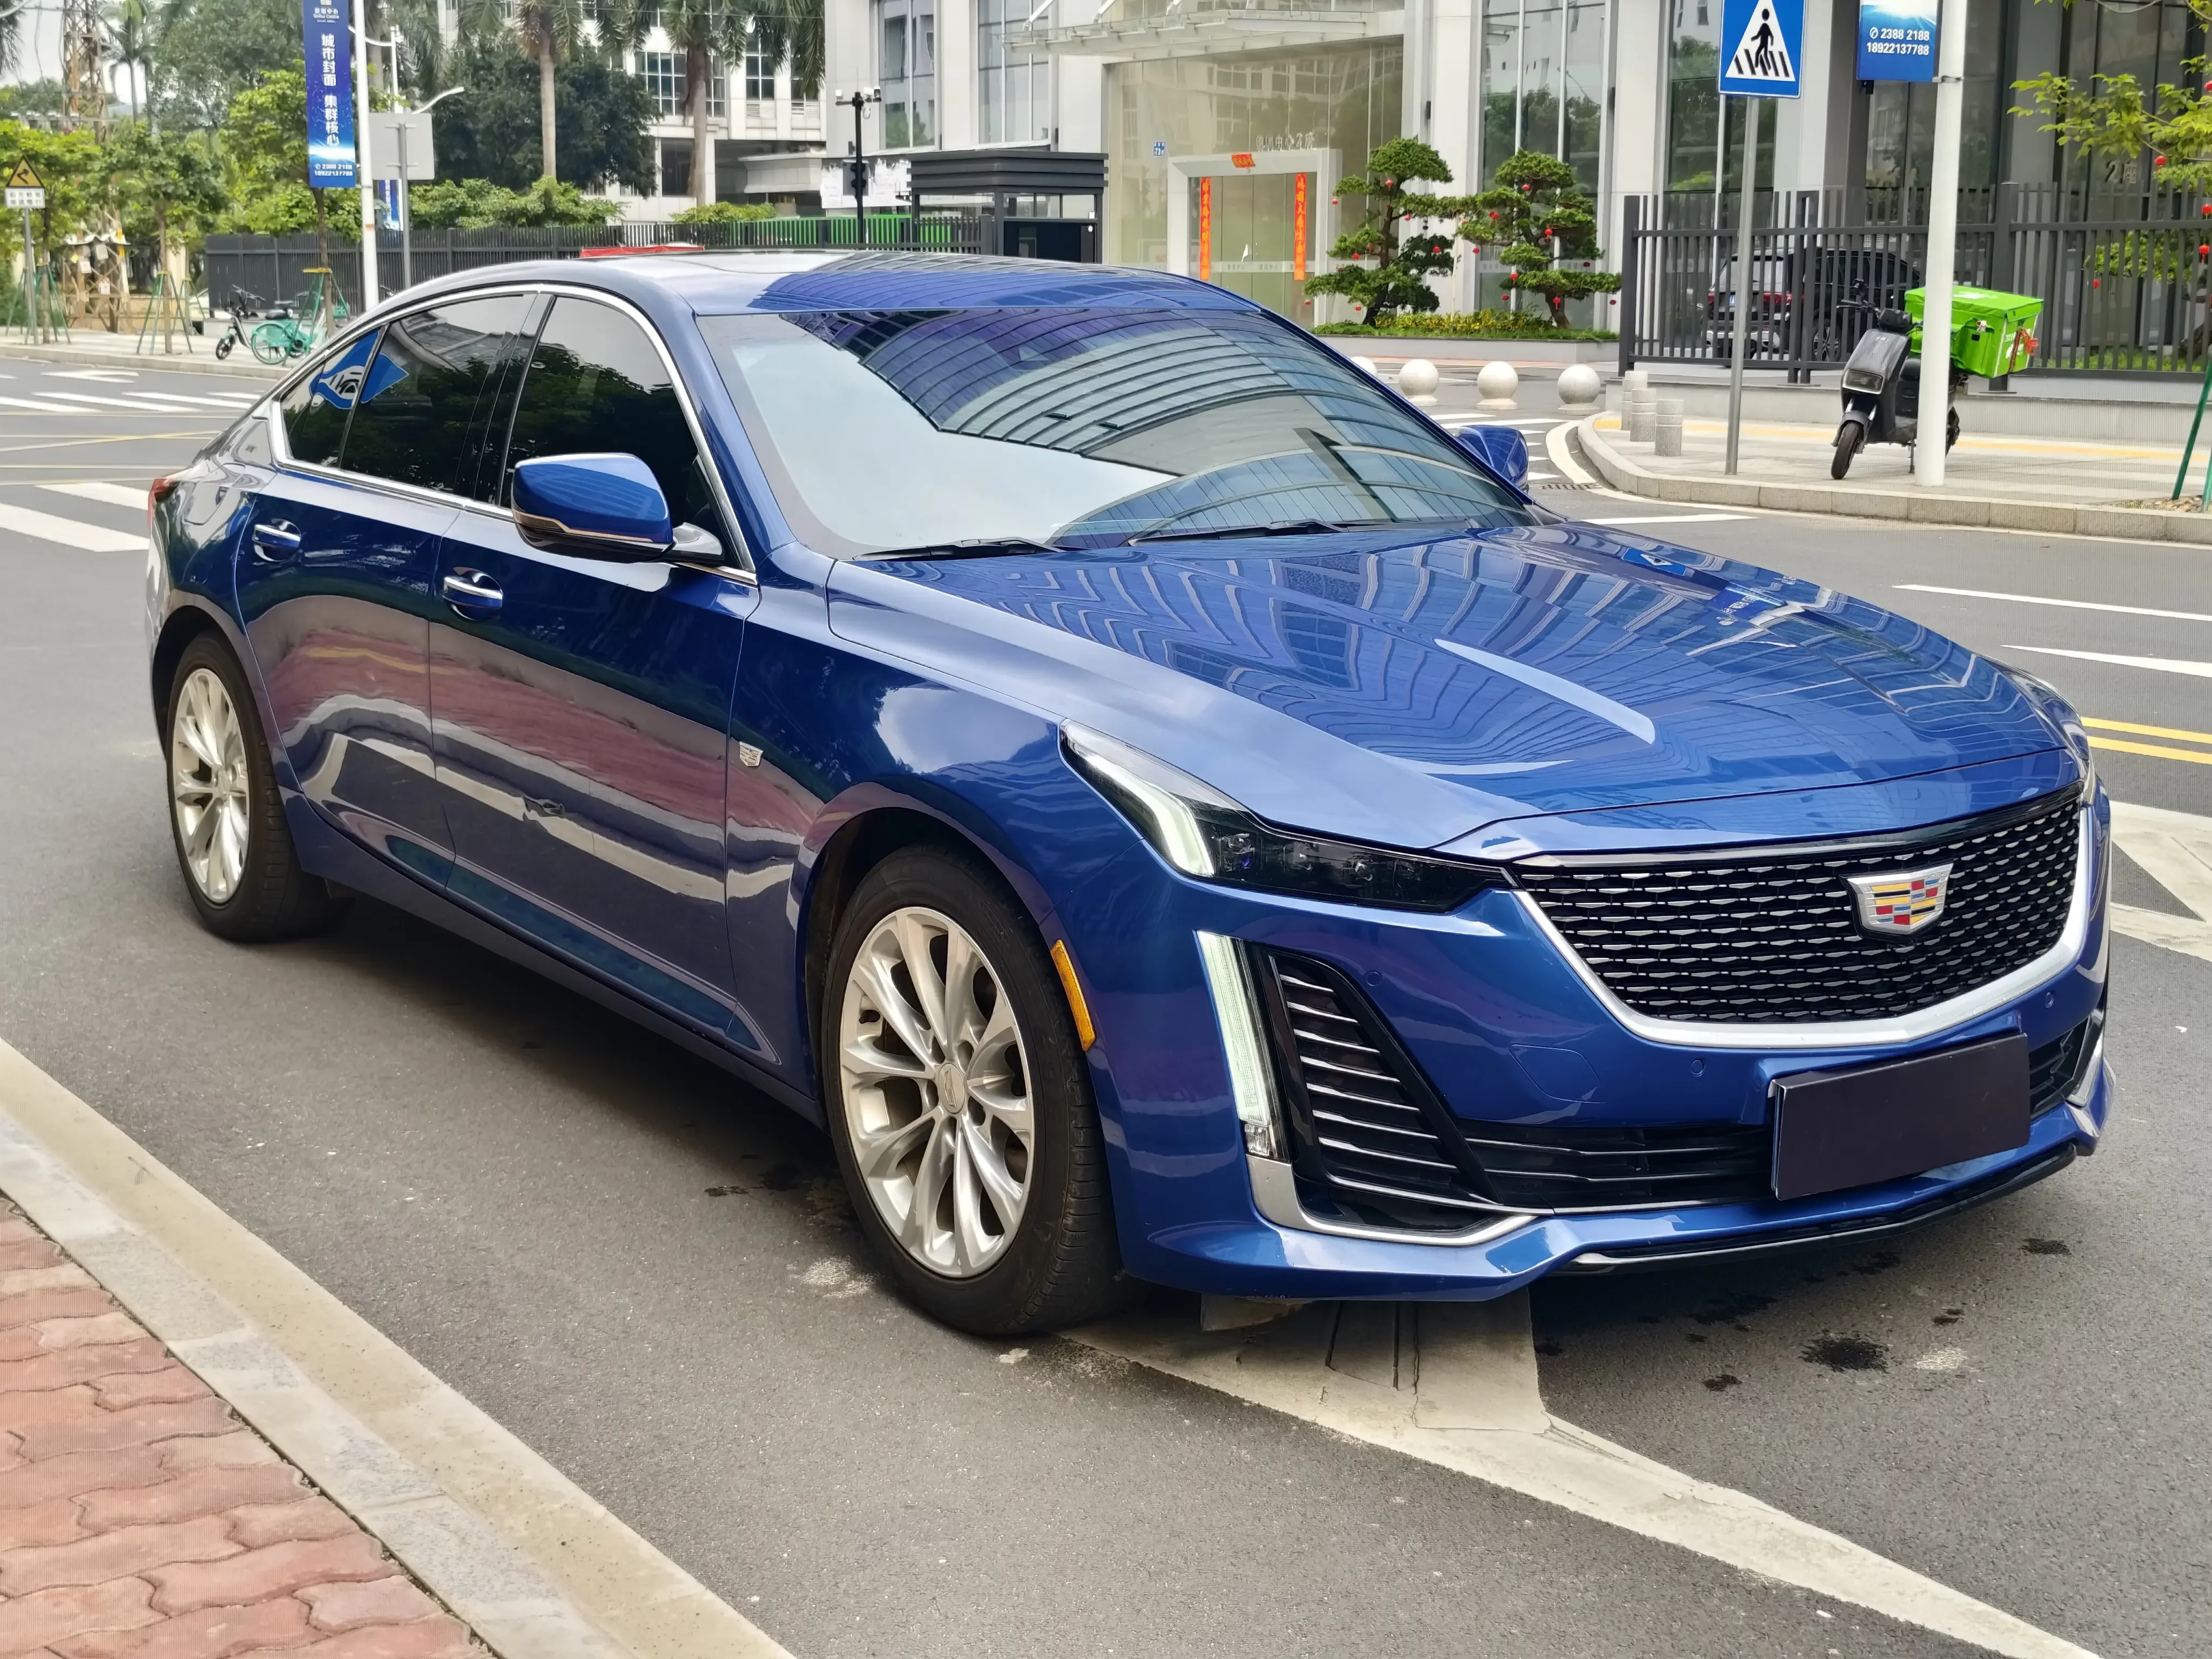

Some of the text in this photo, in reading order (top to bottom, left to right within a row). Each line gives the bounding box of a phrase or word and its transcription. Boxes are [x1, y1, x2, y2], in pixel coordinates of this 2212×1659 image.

[1866, 42, 1930, 55] 18922137788
[1880, 28, 1930, 41] 2388 2188
[321, 33, 336, 86] 城市封面
[325, 95, 339, 146] 集群核心
